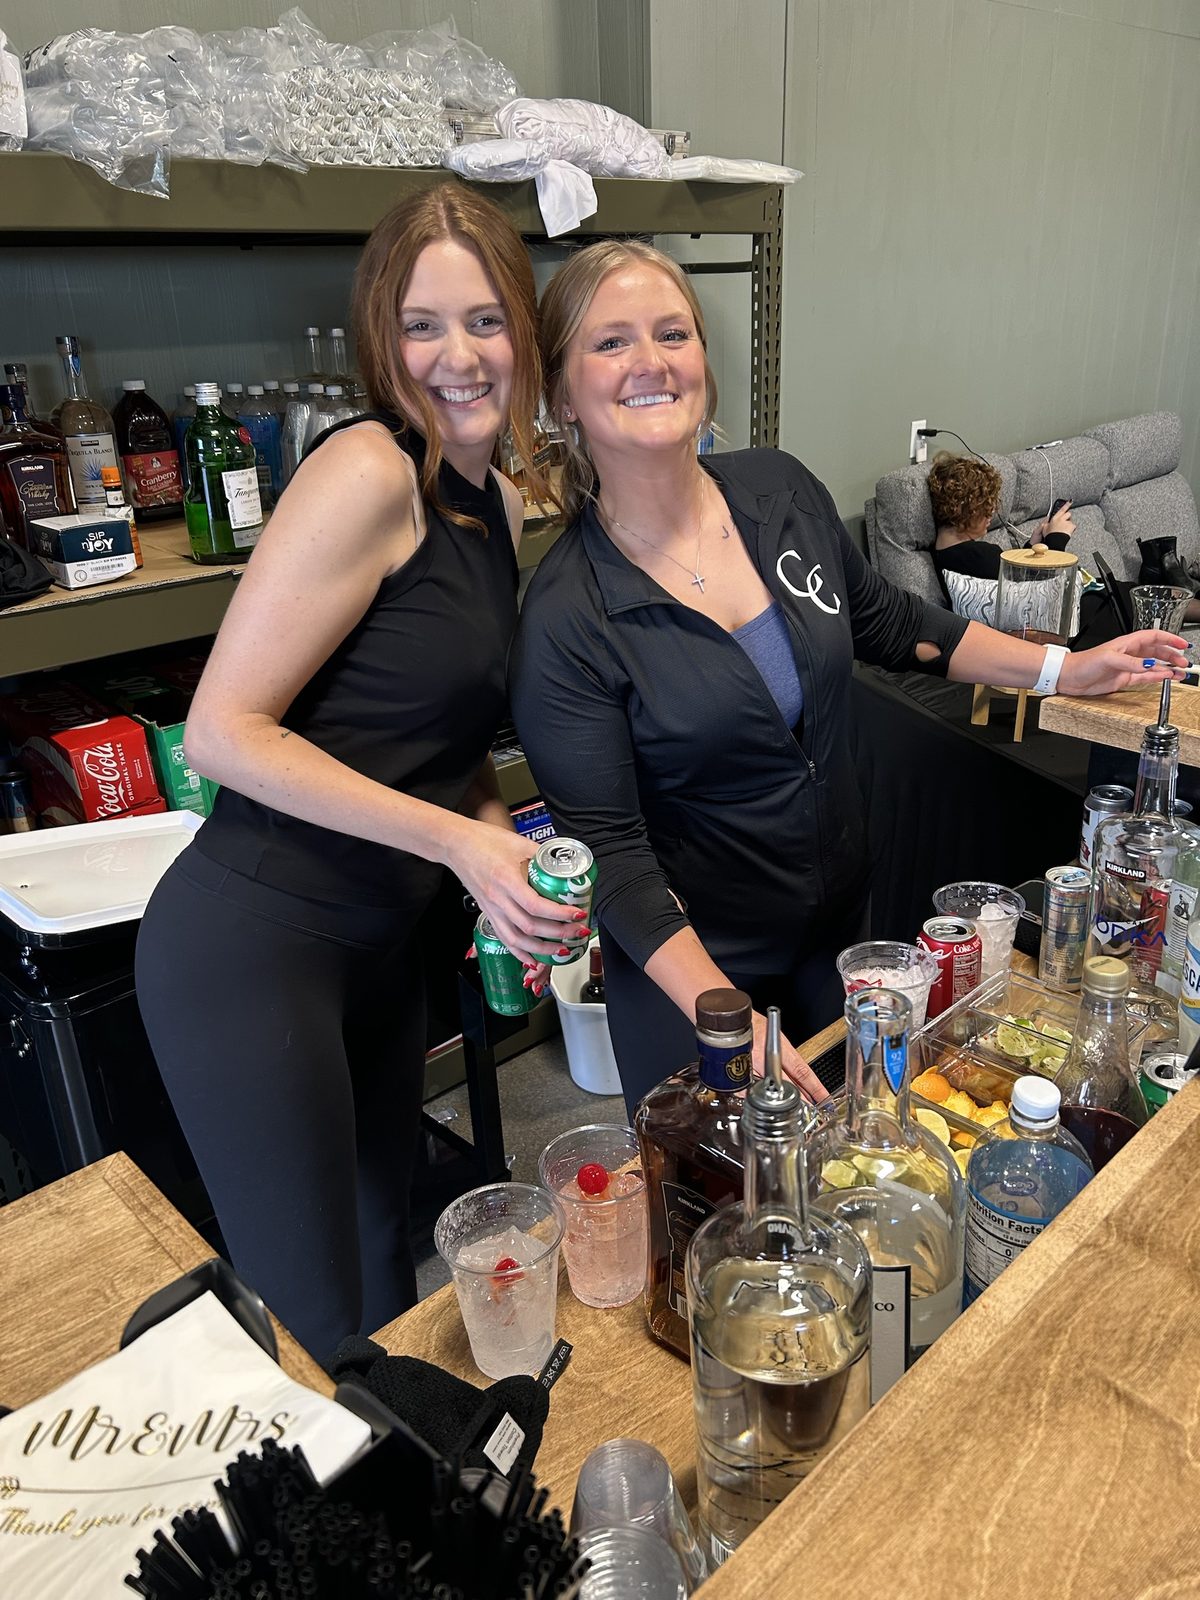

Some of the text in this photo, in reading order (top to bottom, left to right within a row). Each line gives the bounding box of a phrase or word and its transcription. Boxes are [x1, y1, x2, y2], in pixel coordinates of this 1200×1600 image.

[141, 470, 177, 487] Cranberry
[88, 531, 105, 541] SIP
[116, 743, 134, 801] ORIGINAL TASTE
[1106, 862, 1145, 878] KIRKLAND
[482, 943, 510, 955] Sprite
[1008, 1219, 1042, 1236] Facts
[0, 1507, 78, 1537] Thank
